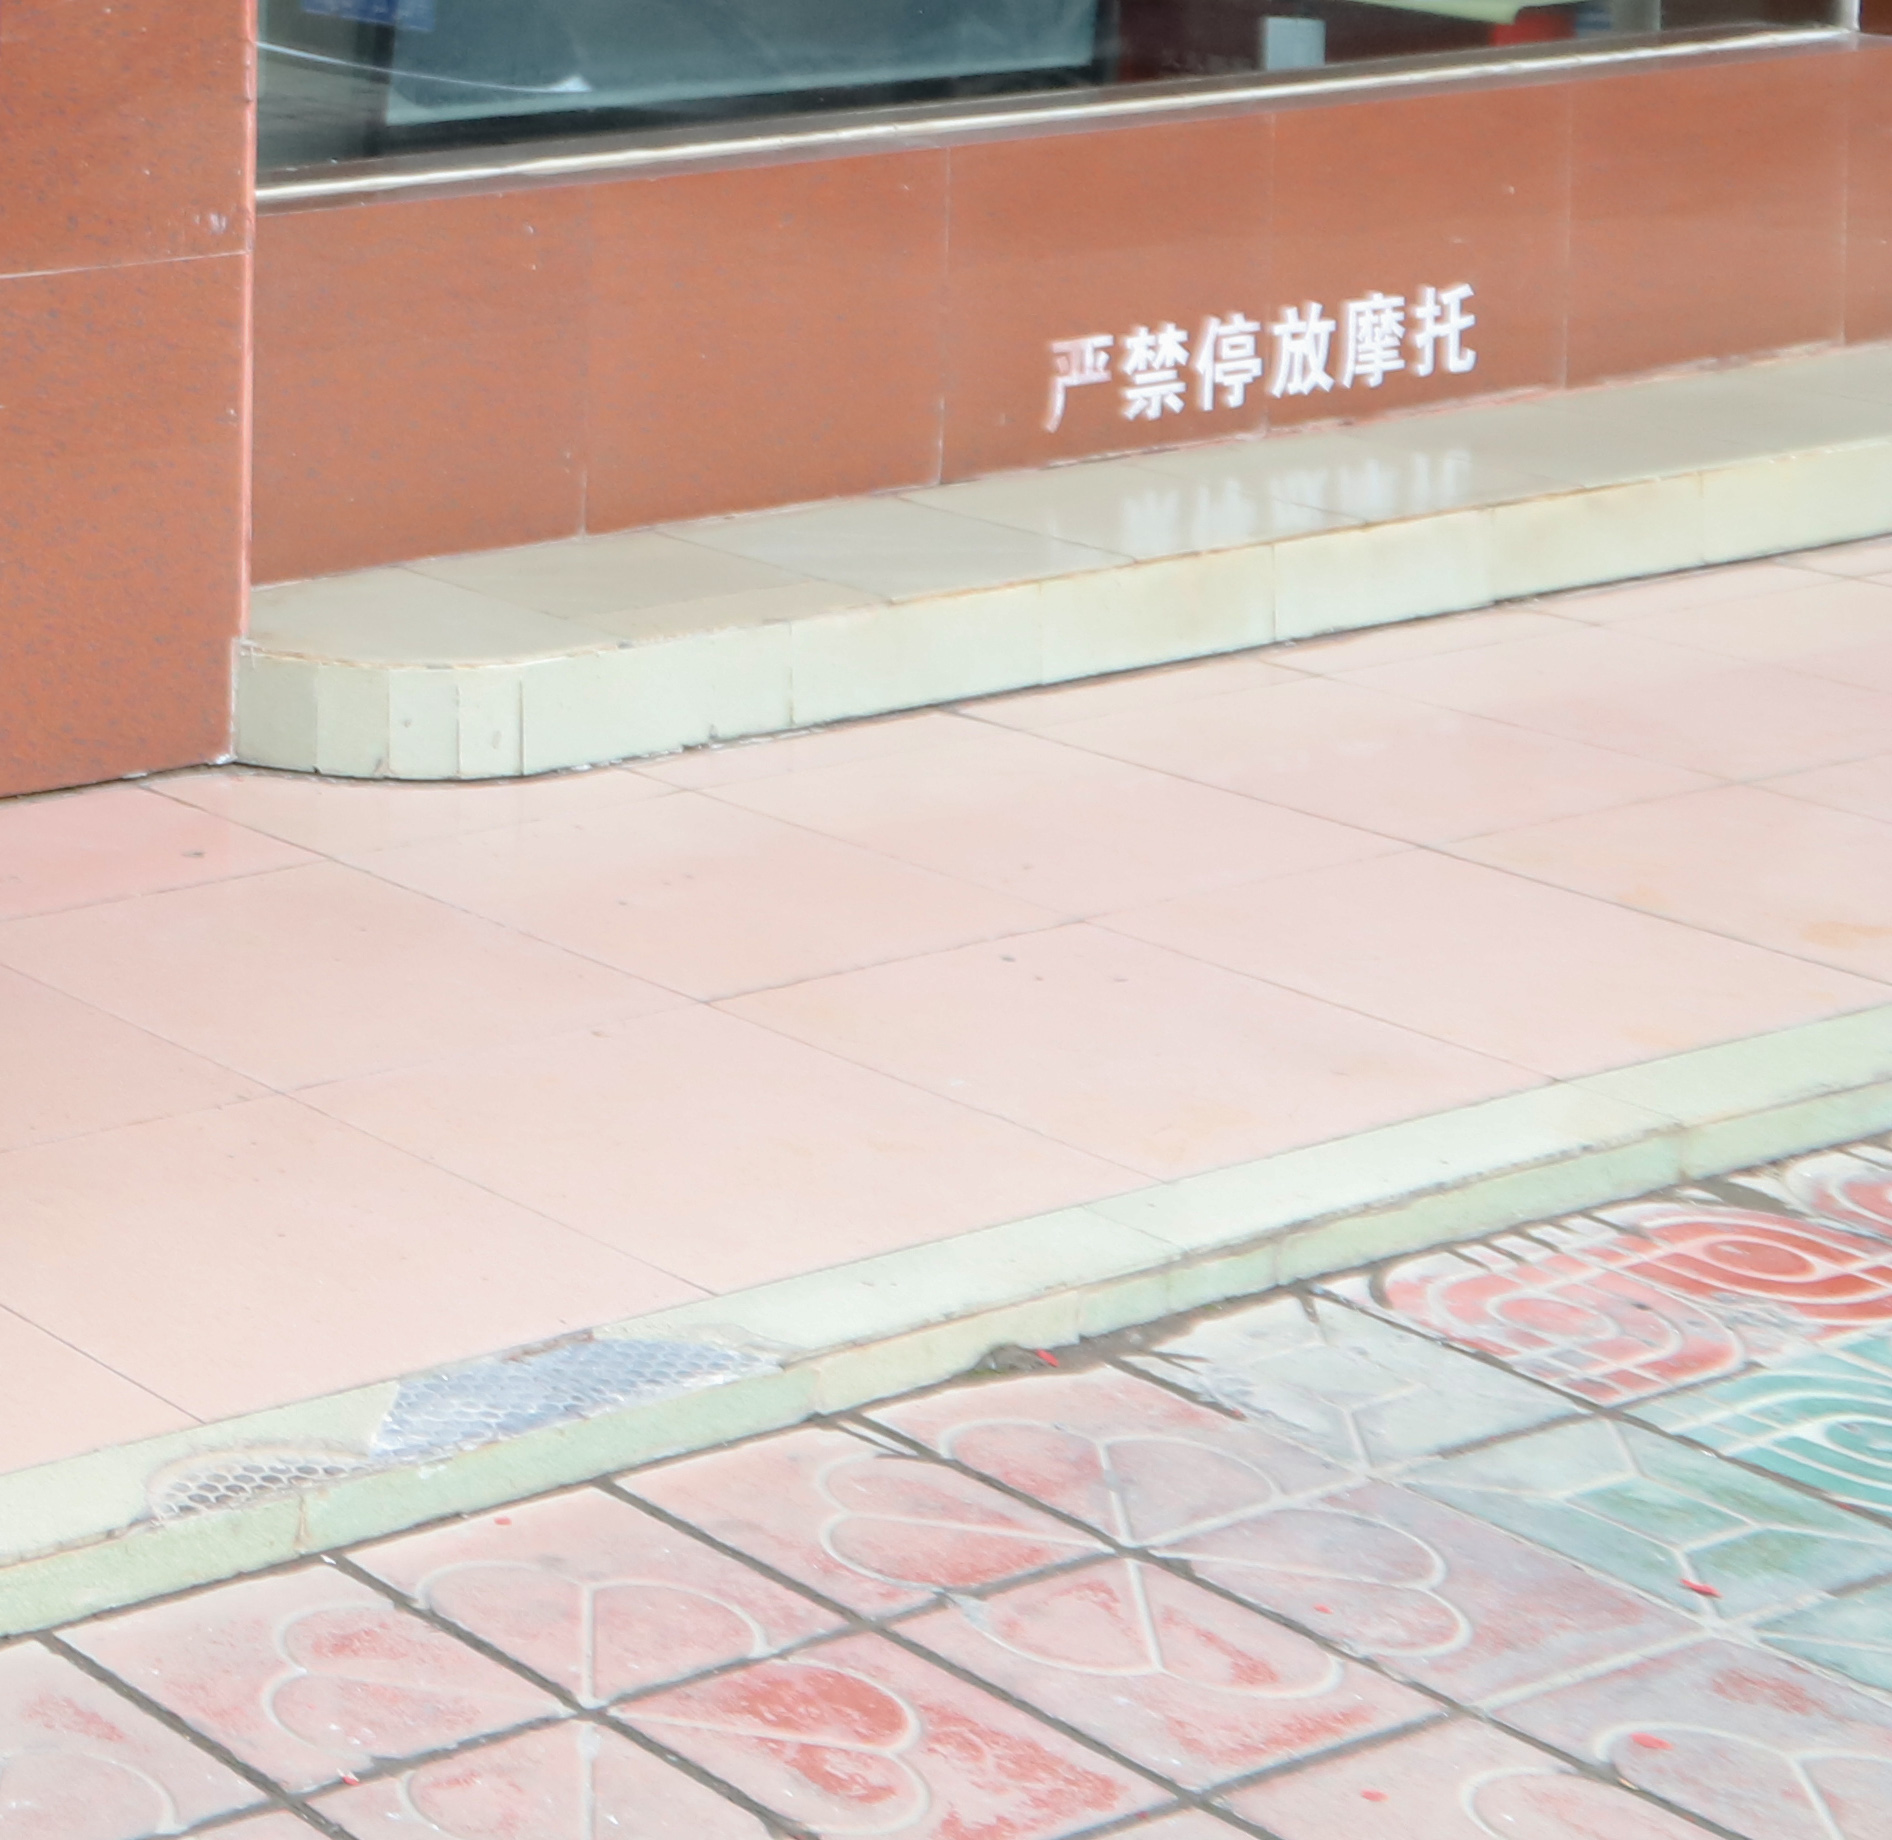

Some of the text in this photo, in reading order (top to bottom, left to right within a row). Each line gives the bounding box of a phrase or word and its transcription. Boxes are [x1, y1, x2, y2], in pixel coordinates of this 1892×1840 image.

[1042, 282, 1477, 432] 严禁停放摩托
